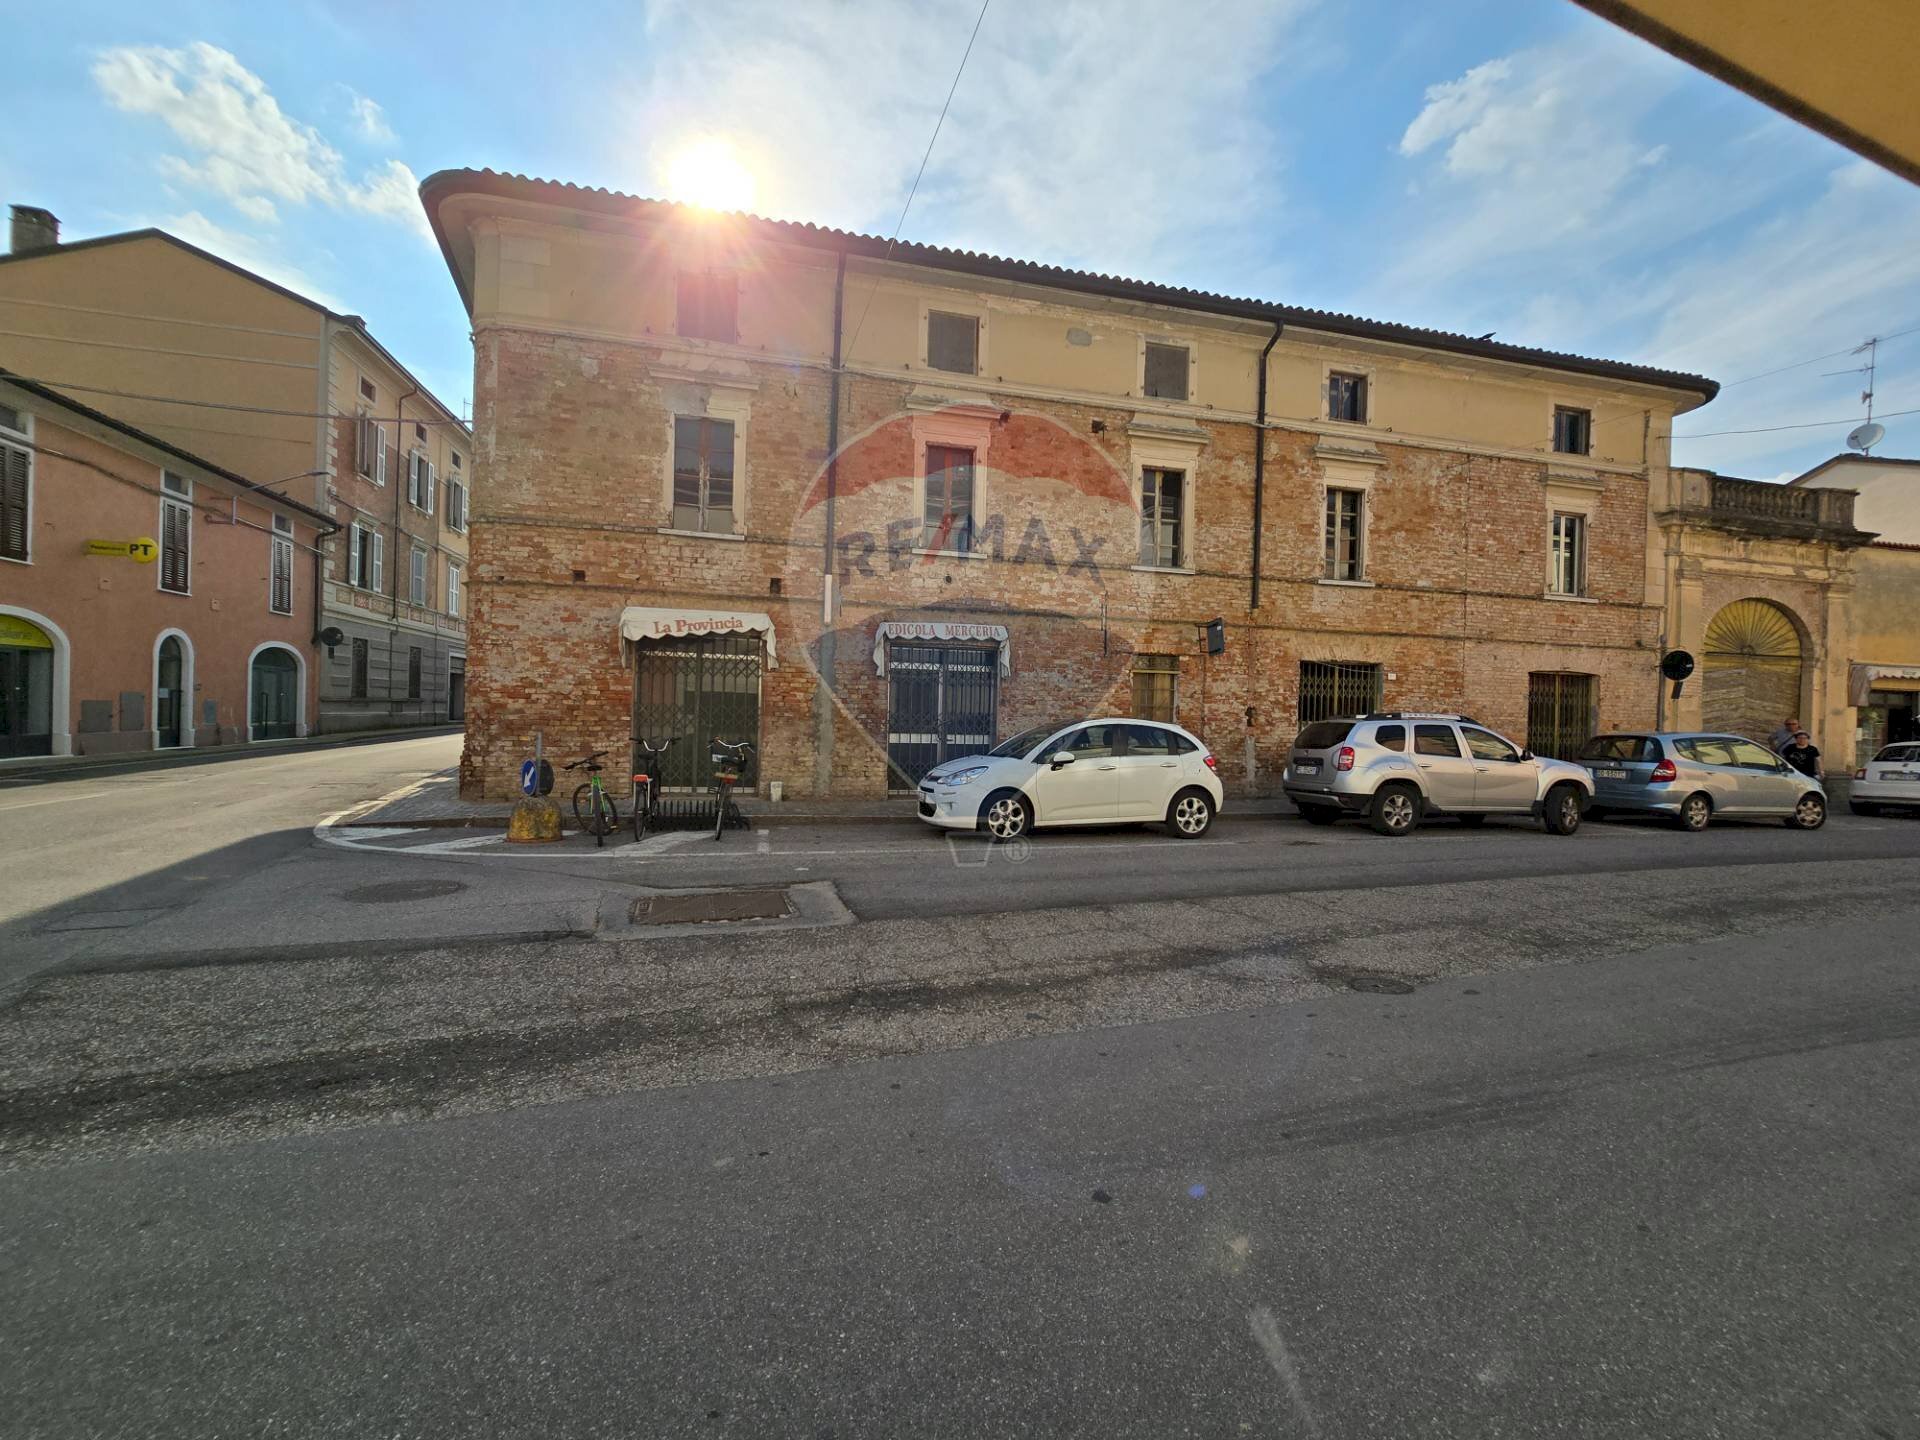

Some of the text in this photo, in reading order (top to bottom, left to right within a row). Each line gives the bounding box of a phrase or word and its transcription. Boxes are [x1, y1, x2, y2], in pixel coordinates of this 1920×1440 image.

[129, 543, 153, 556] PT
[653, 616, 744, 634] La Provincia
[888, 623, 1001, 638] EDICOLA MERCERIA
